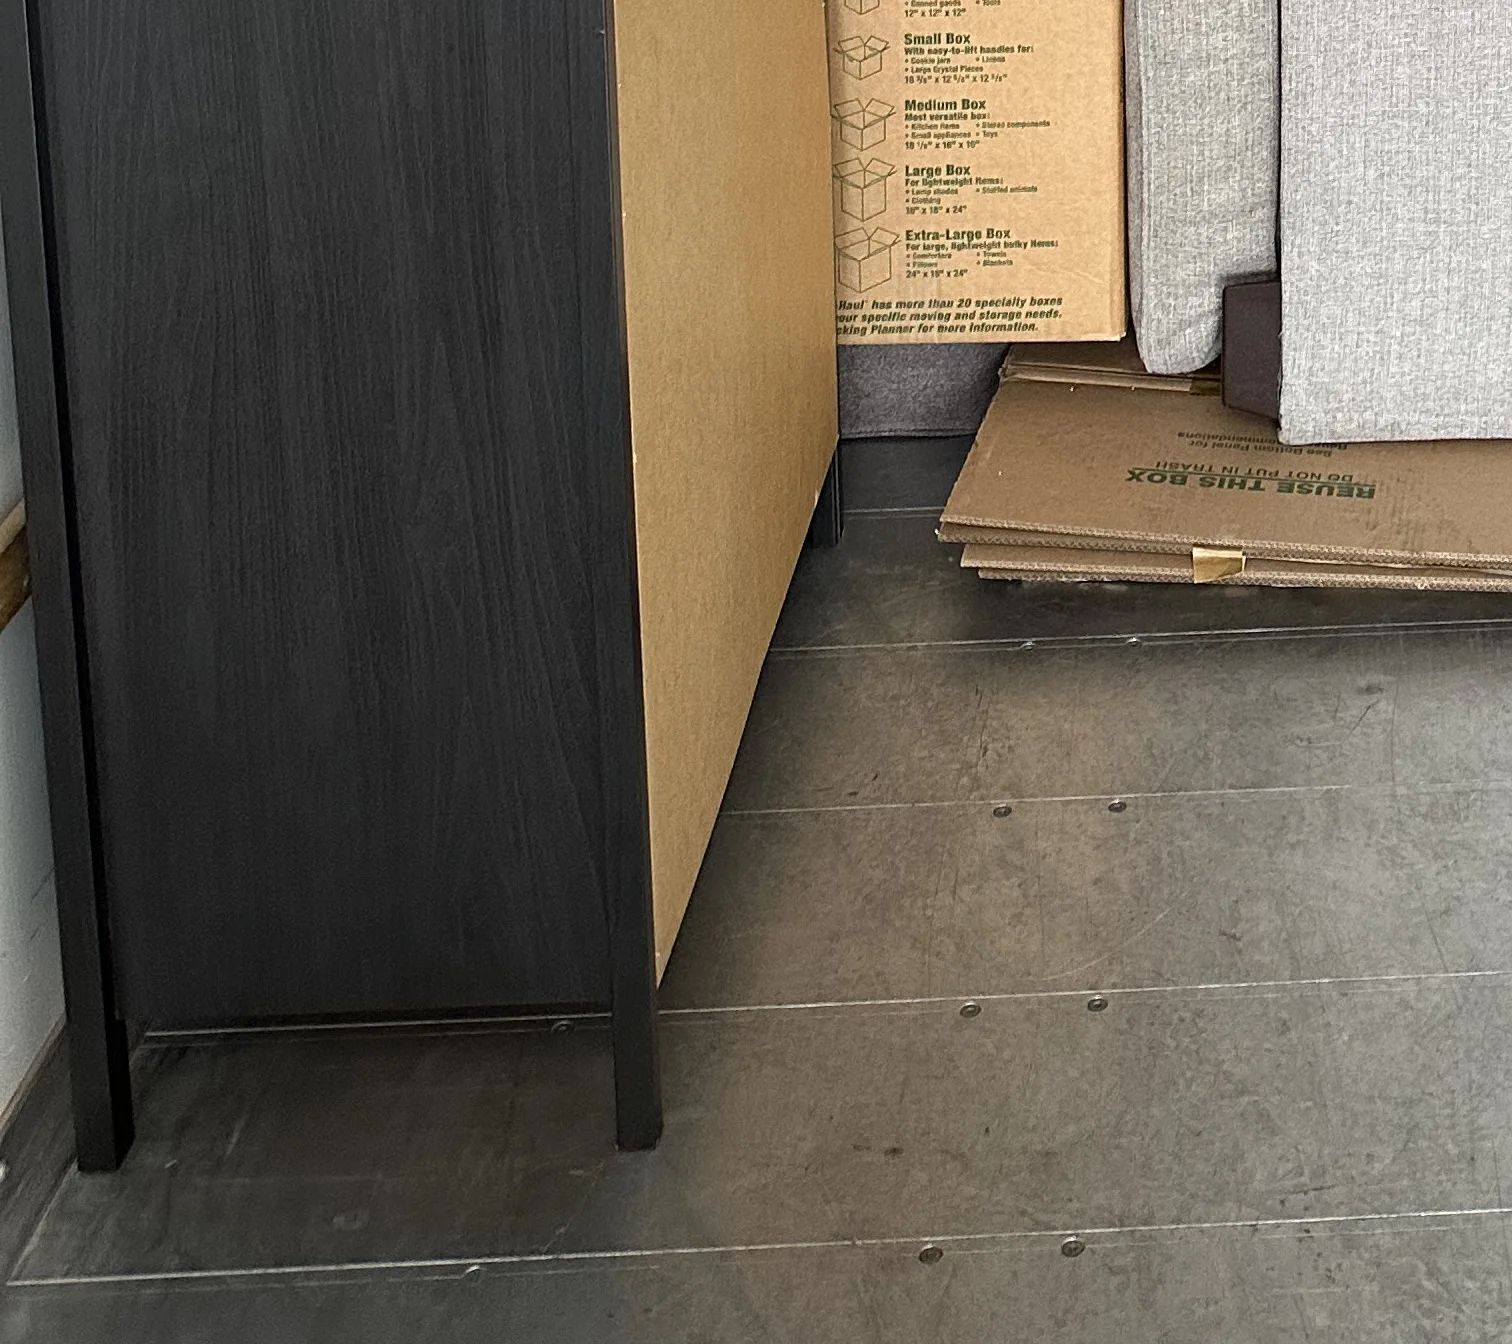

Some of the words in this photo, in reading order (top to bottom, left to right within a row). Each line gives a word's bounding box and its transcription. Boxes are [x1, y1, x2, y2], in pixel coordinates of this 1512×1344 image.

[904, 32, 942, 45] Small
[946, 32, 971, 44] Box
[904, 99, 957, 111] Medium
[961, 98, 986, 110] Box
[905, 165, 942, 178] Large
[946, 164, 971, 176] Box
[905, 228, 982, 242] Extra-Large
[986, 228, 1011, 239] Box
[871, 299, 892, 309] has
[895, 300, 925, 309] more
[928, 298, 954, 309] than
[957, 298, 972, 308] 20
[975, 296, 1027, 309] specialty
[1029, 296, 1063, 306] boxes
[861, 312, 907, 324] specific
[909, 312, 951, 322] moving
[954, 310, 976, 320] and
[979, 310, 1022, 321] storage
[1025, 308, 1063, 319] needs.
[870, 323, 915, 335] Planner
[917, 323, 935, 333] for
[937, 324, 966, 333] more
[969, 321, 1039, 333] information.
[1155, 460, 1215, 473] TRASH
[1221, 465, 1240, 476] IN
[1246, 467, 1280, 478] PUT
[1125, 468, 1189, 486] BOX
[1286, 470, 1322, 481] NOT
[1329, 473, 1353, 483] DO
[1199, 475, 1265, 493] THIS
[1276, 481, 1377, 500] REUSE
